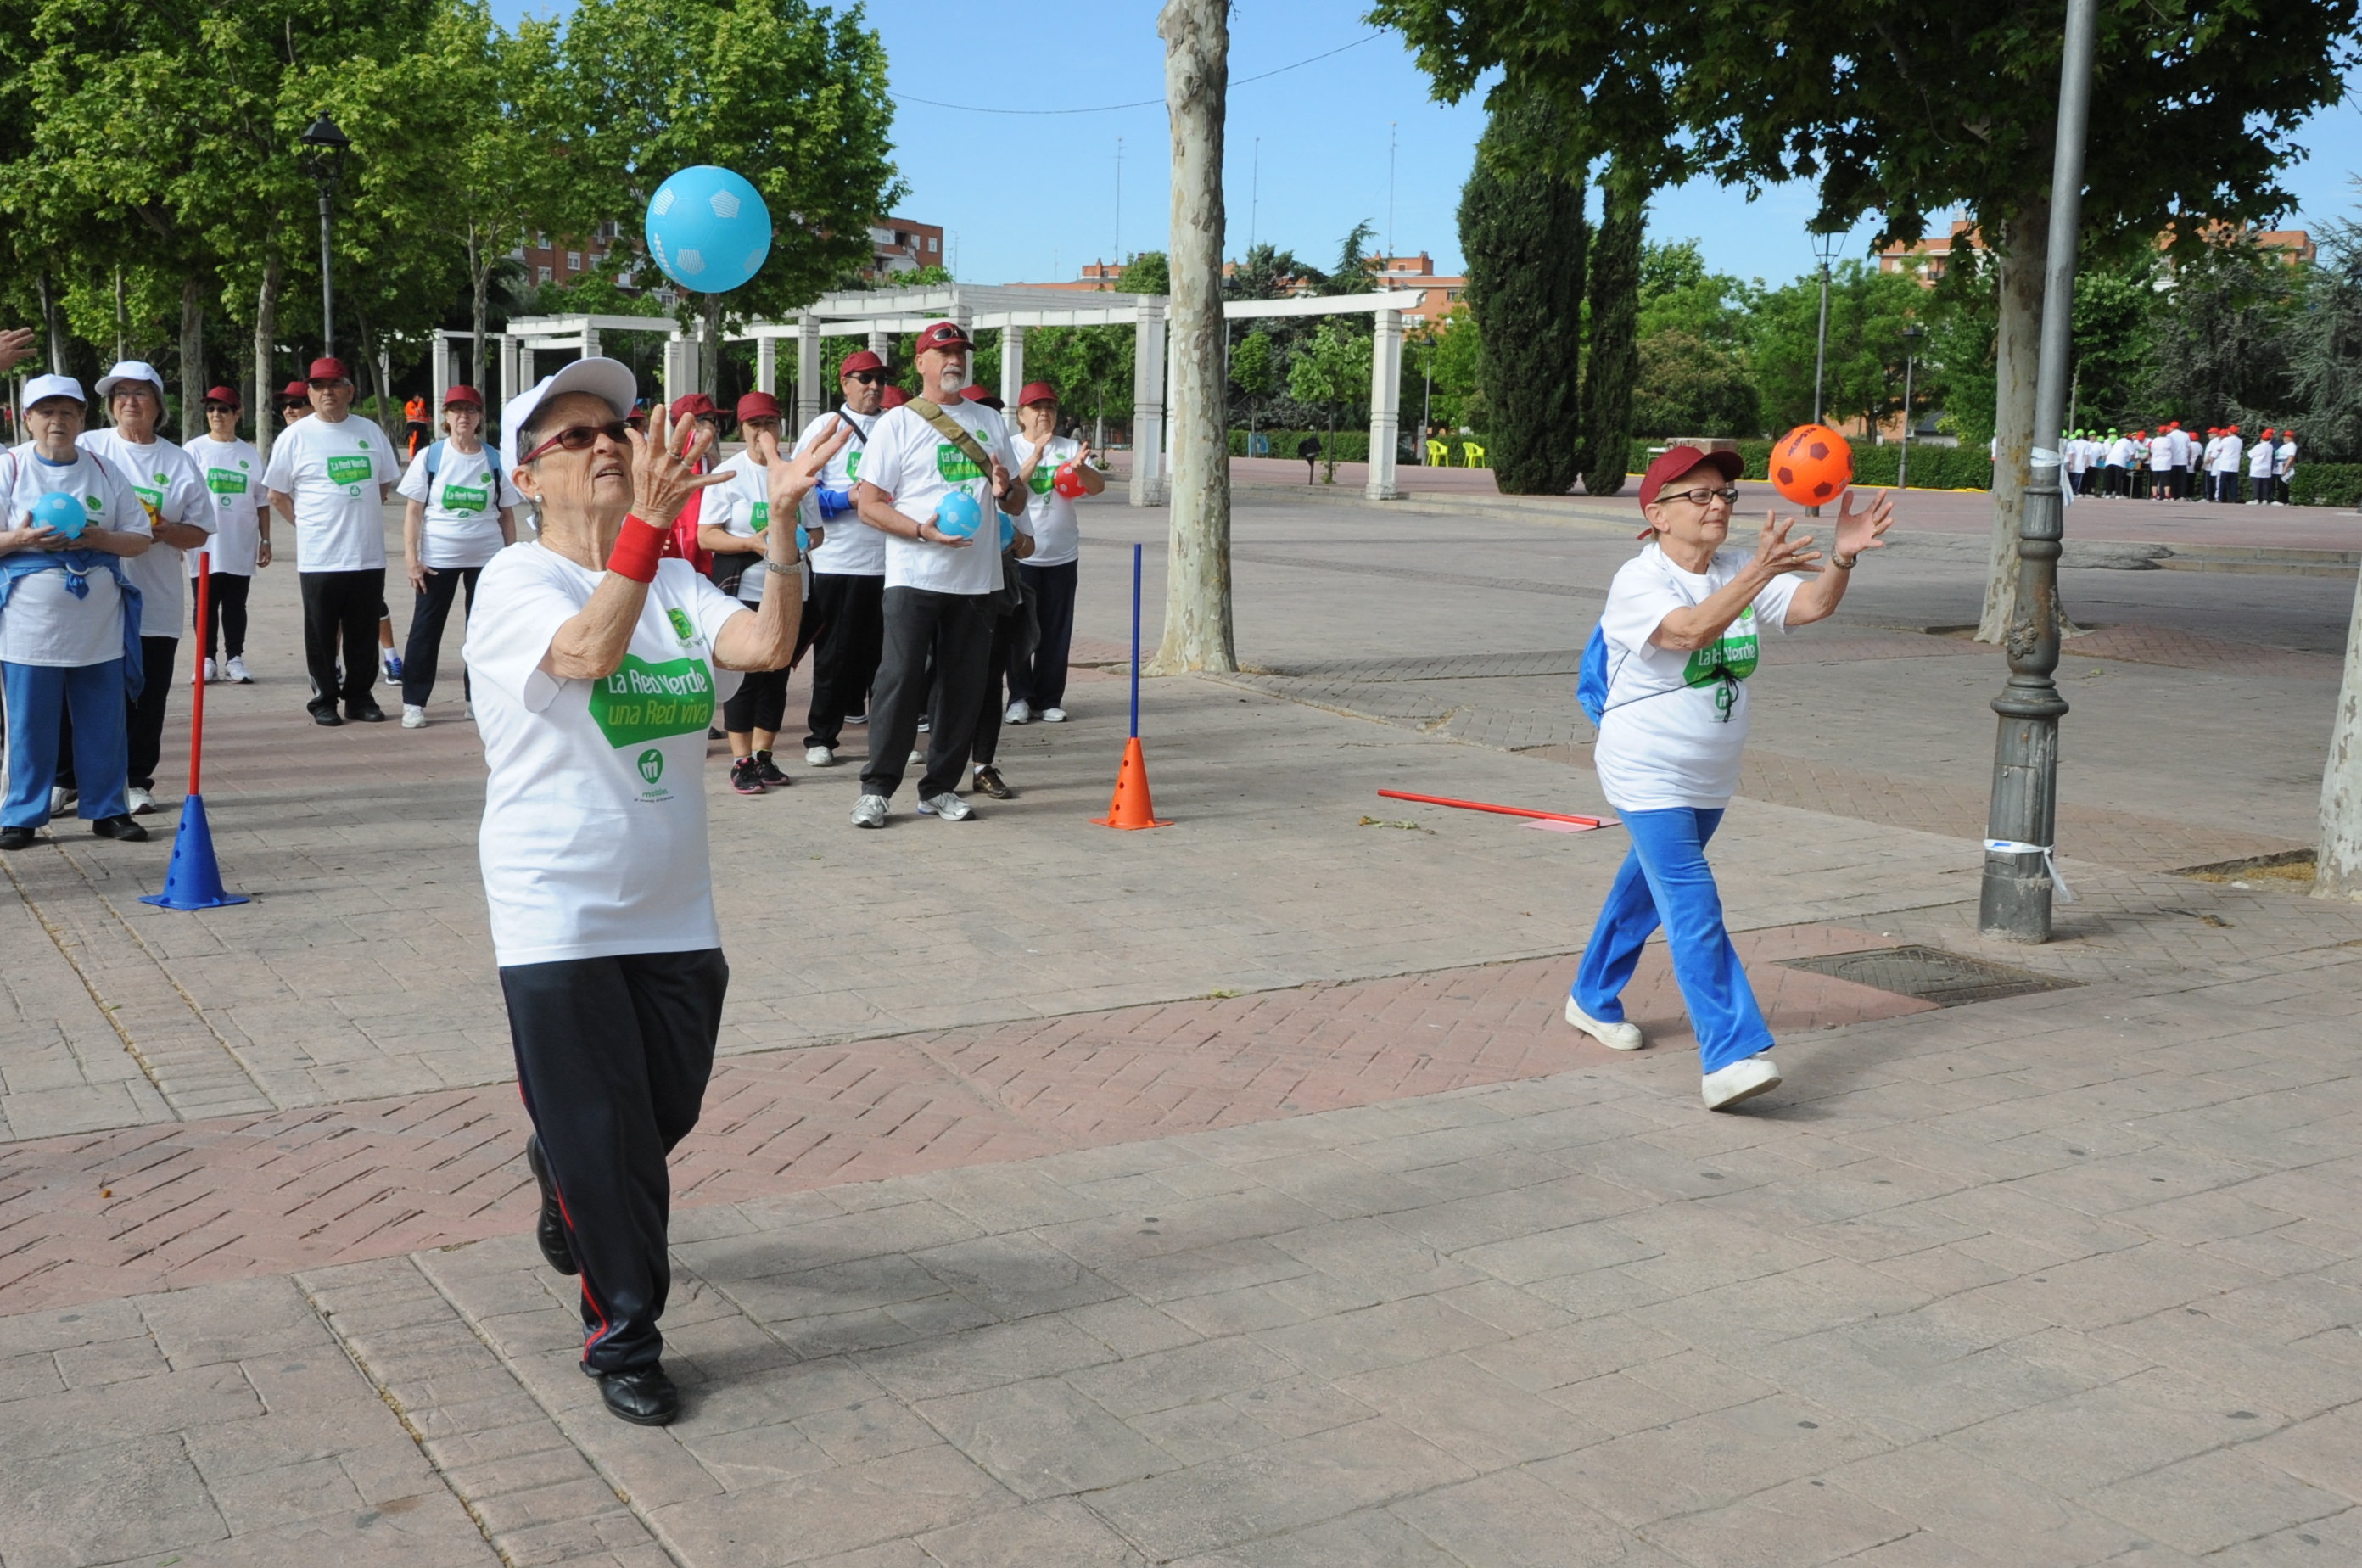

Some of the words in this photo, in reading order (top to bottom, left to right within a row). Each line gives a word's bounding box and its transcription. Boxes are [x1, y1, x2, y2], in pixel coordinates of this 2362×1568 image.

[756, 508, 765, 518] La
[1699, 648, 1710, 666] La
[1724, 641, 1755, 662] Verde
[607, 674, 628, 694] La
[629, 669, 663, 694] Red
[658, 667, 708, 696] Verde
[607, 705, 641, 726] una
[645, 699, 677, 725] Red
[681, 698, 709, 725] viva
